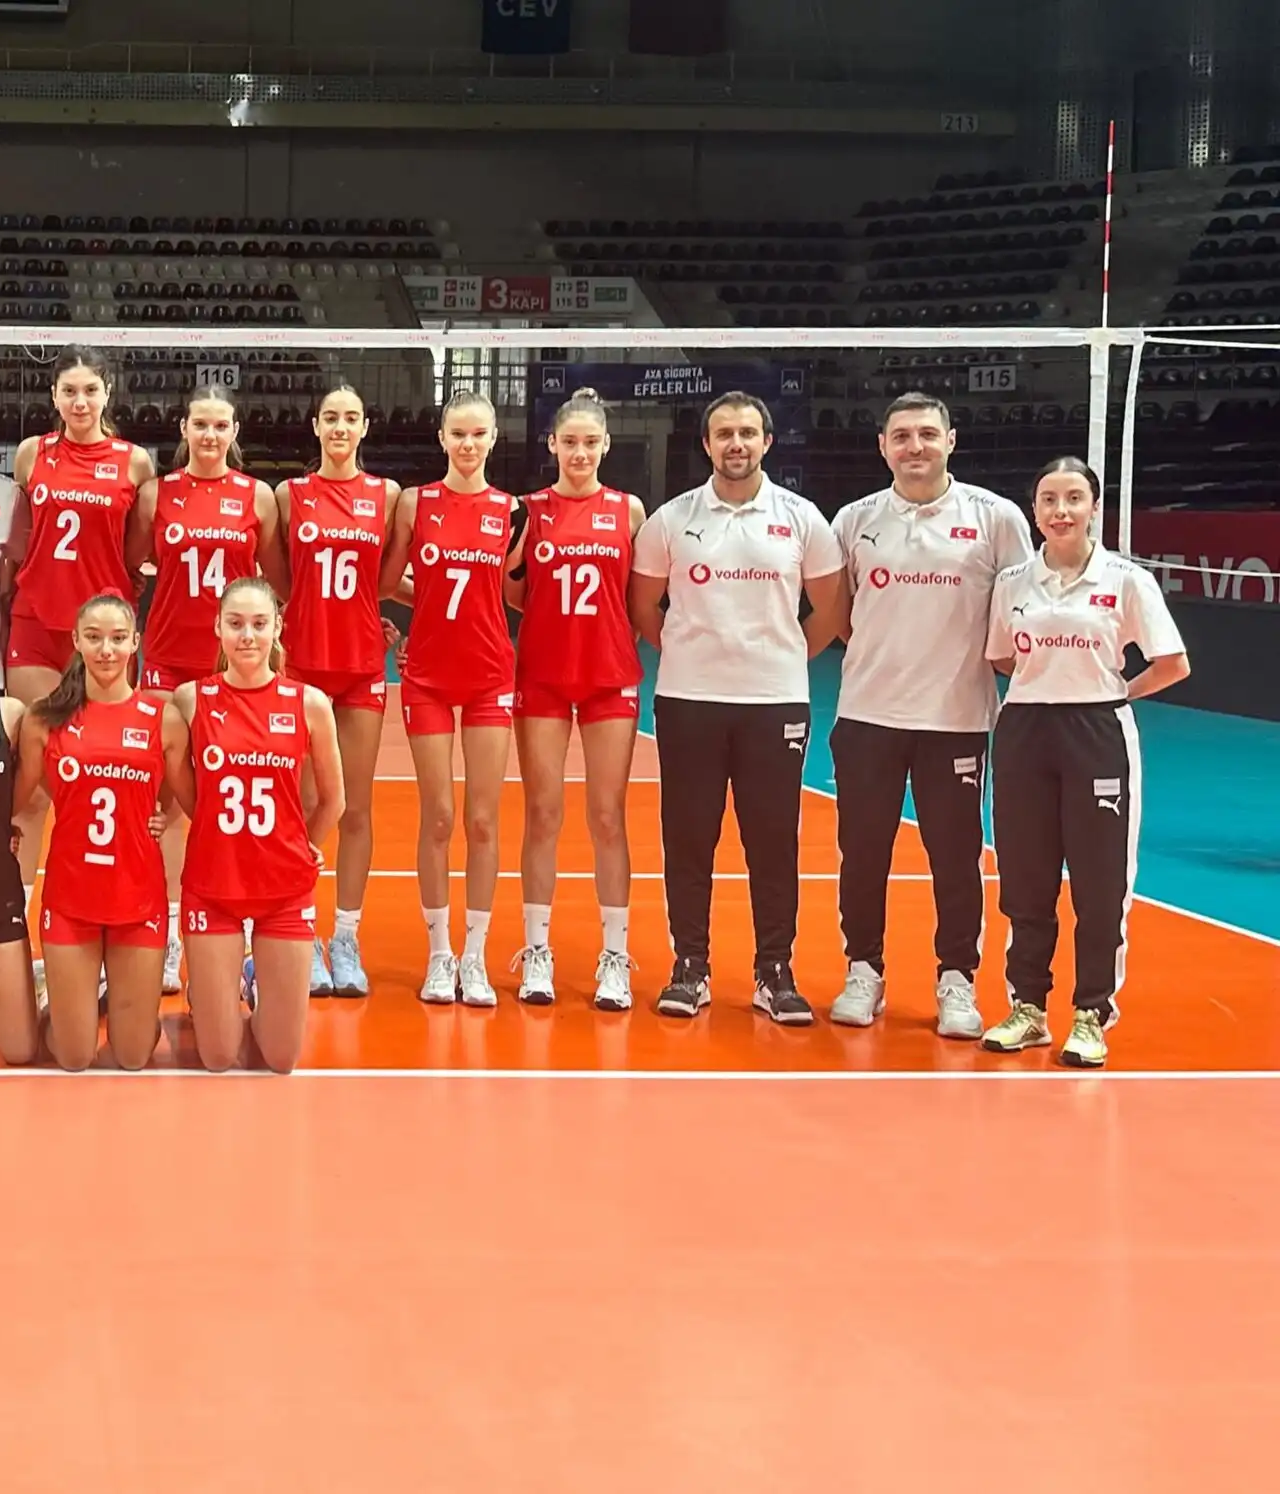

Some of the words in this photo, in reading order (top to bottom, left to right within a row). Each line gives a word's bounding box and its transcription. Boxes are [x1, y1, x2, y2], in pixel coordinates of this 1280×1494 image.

[496, 0, 558, 17] CEV
[943, 115, 974, 131] 213
[488, 279, 508, 309] 3
[510, 297, 544, 309] KAPI
[200, 366, 235, 387] 116
[973, 369, 1011, 388] 115
[633, 382, 684, 397] EFELER
[51, 489, 112, 507] vodafone
[53, 509, 81, 561] 2
[187, 526, 247, 543] vodafone
[321, 526, 380, 546] vodafone
[442, 548, 502, 567] vodafone
[558, 542, 620, 559] vodafone
[180, 547, 227, 598] 14
[314, 547, 359, 600] 16
[715, 567, 781, 582] vodafone
[893, 572, 963, 587] vodafone
[1198, 556, 1280, 602] VO
[446, 568, 471, 620] 7
[552, 563, 600, 616] 12
[1034, 633, 1103, 651] vodafone
[146, 670, 161, 687] 14
[228, 751, 295, 769] vodafone
[83, 763, 151, 783] vodafone
[218, 775, 276, 837] 35
[88, 787, 116, 846] 3
[43, 909, 52, 930] 3
[188, 911, 208, 932] 35
